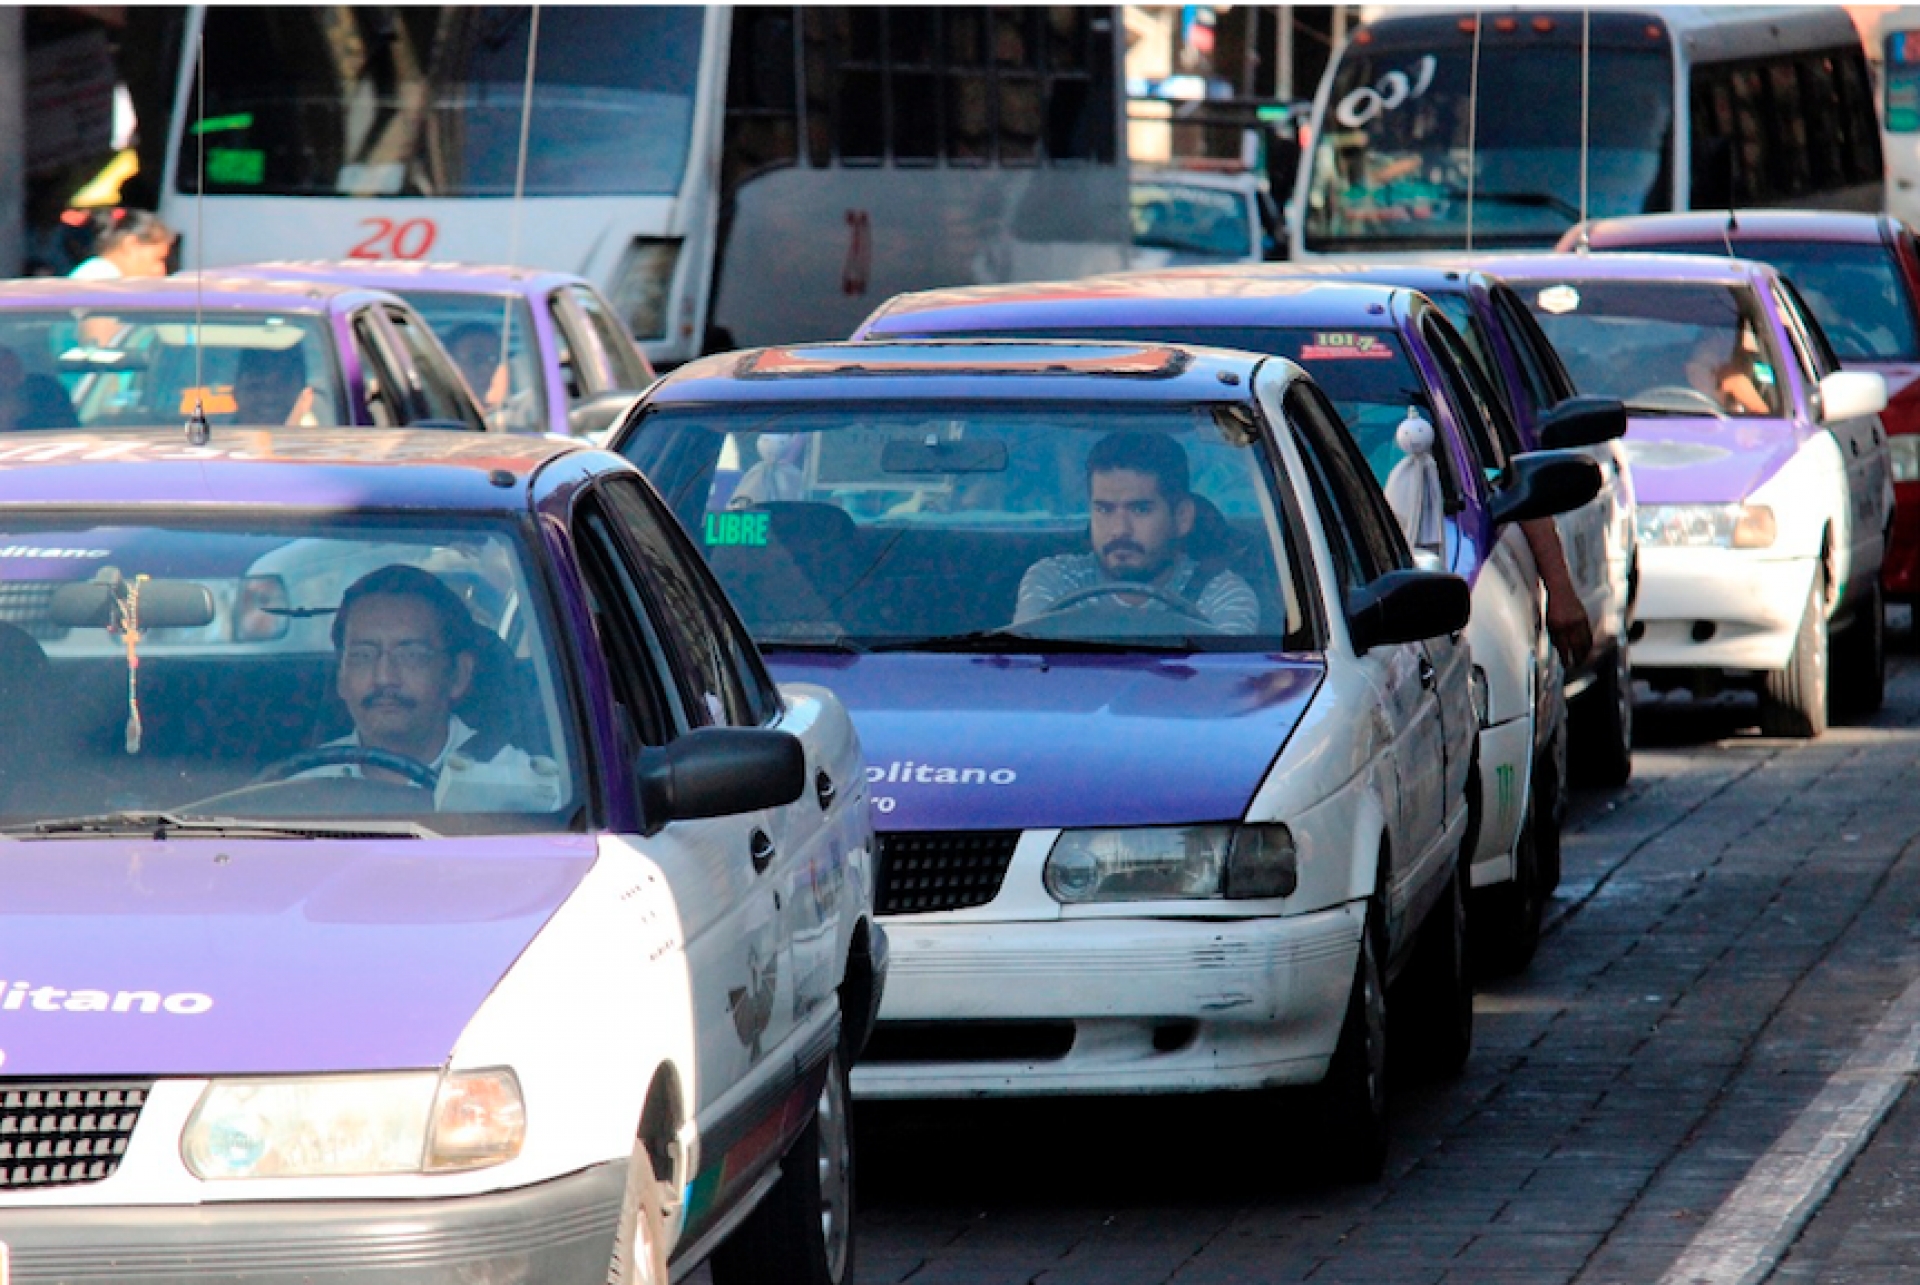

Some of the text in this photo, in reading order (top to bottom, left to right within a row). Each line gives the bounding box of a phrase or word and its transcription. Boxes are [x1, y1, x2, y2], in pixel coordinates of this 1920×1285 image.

[347, 216, 437, 260] 20
[705, 512, 770, 546] LIBRE
[0, 545, 111, 559] litano
[864, 761, 1018, 785] olitano
[0, 979, 214, 1014] itano
